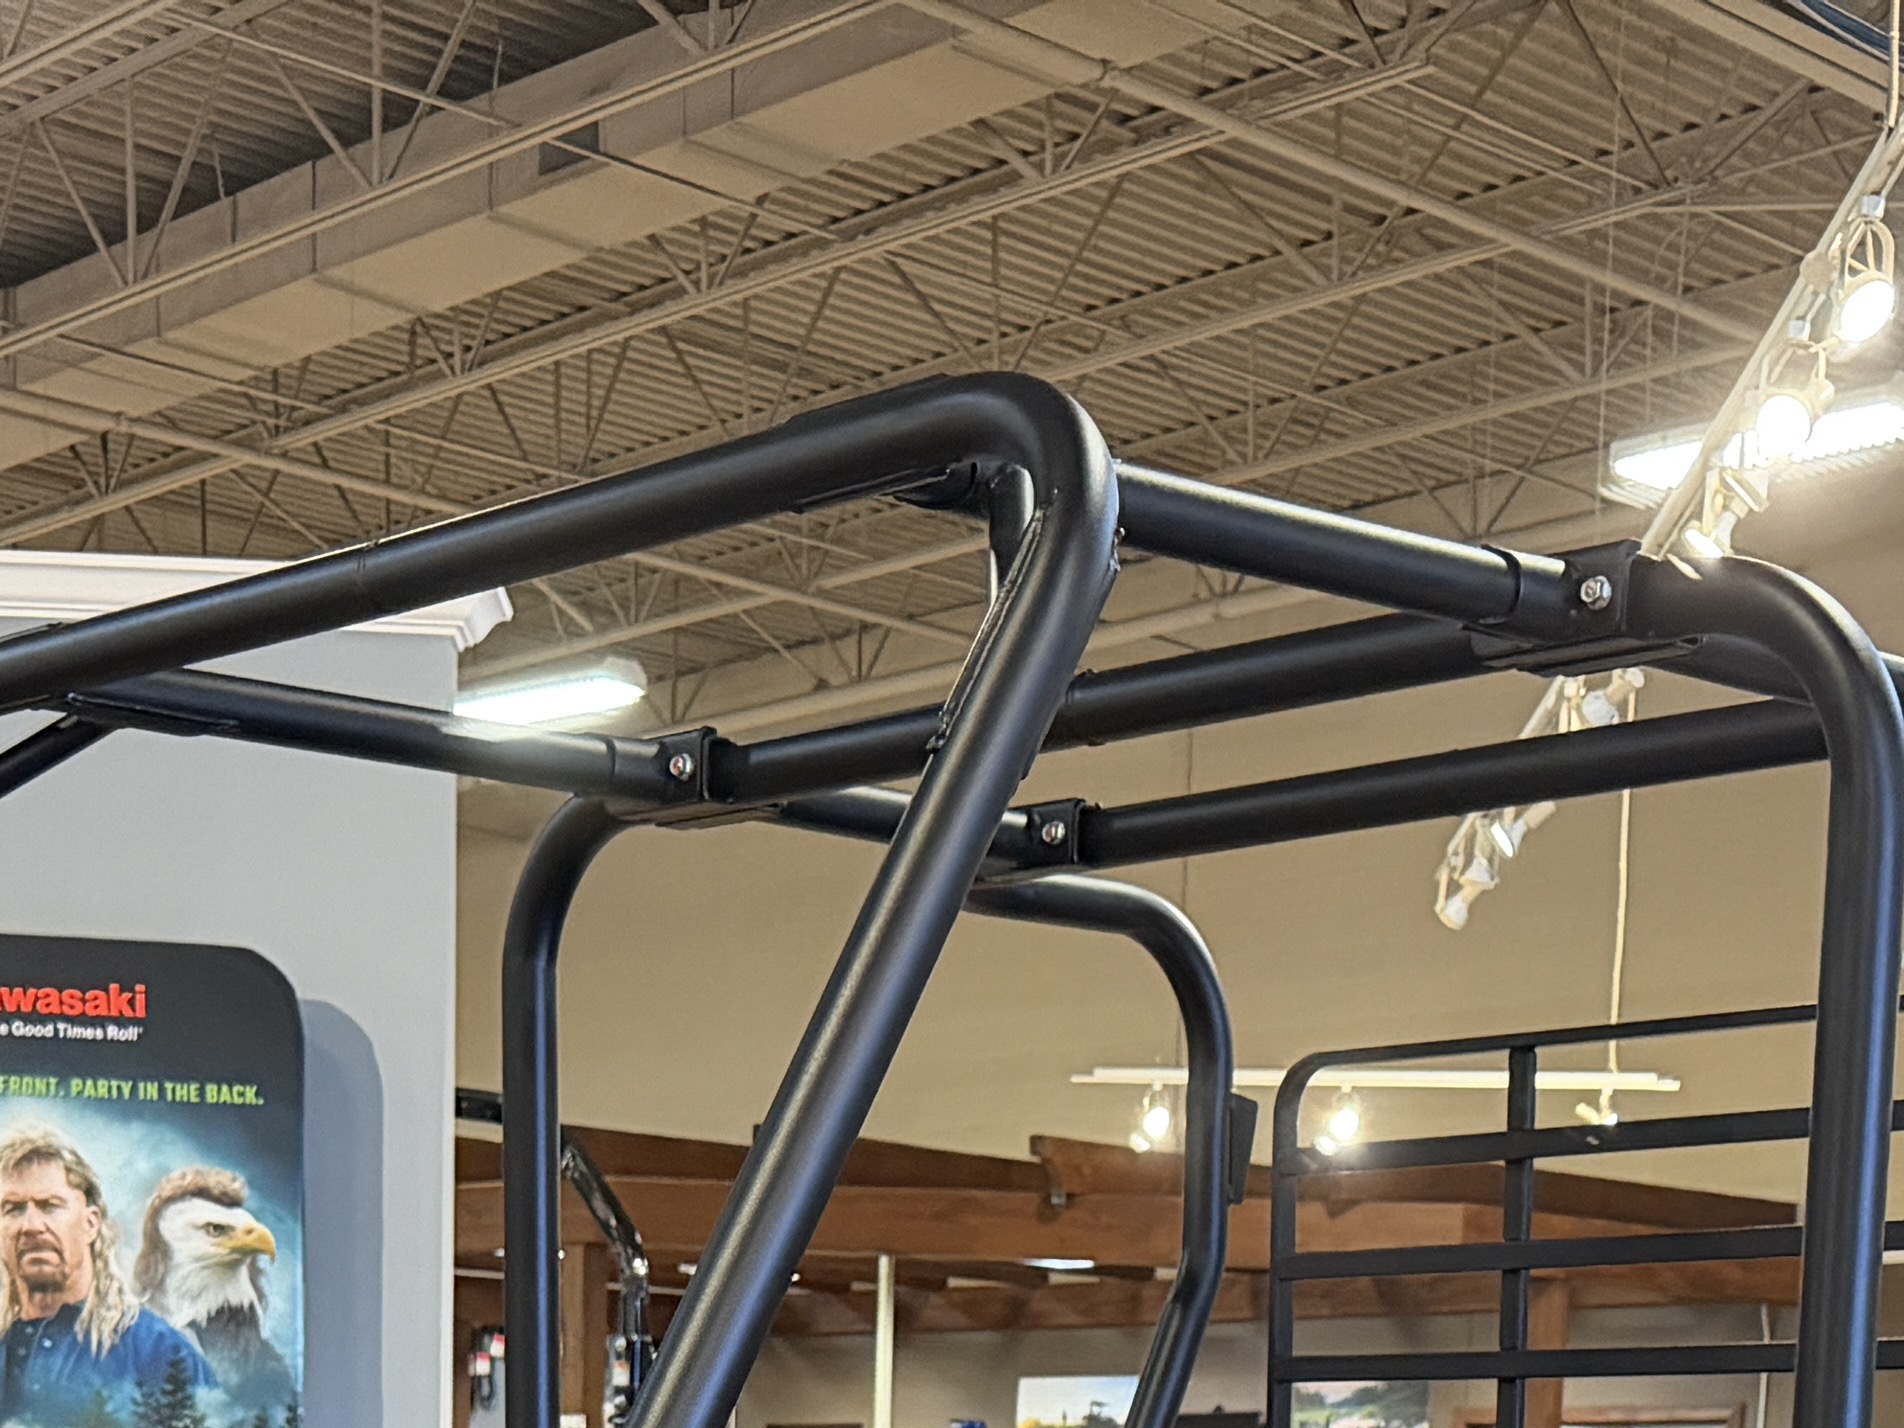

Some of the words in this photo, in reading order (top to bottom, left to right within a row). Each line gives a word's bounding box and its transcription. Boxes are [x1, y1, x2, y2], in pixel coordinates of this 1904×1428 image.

[11, 1020, 54, 1038] Good
[56, 1022, 104, 1040] Times
[70, 1077, 133, 1100] PARTY
[138, 1081, 159, 1100] IN
[164, 1081, 201, 1103] THE
[205, 1083, 264, 1105] BACK.
